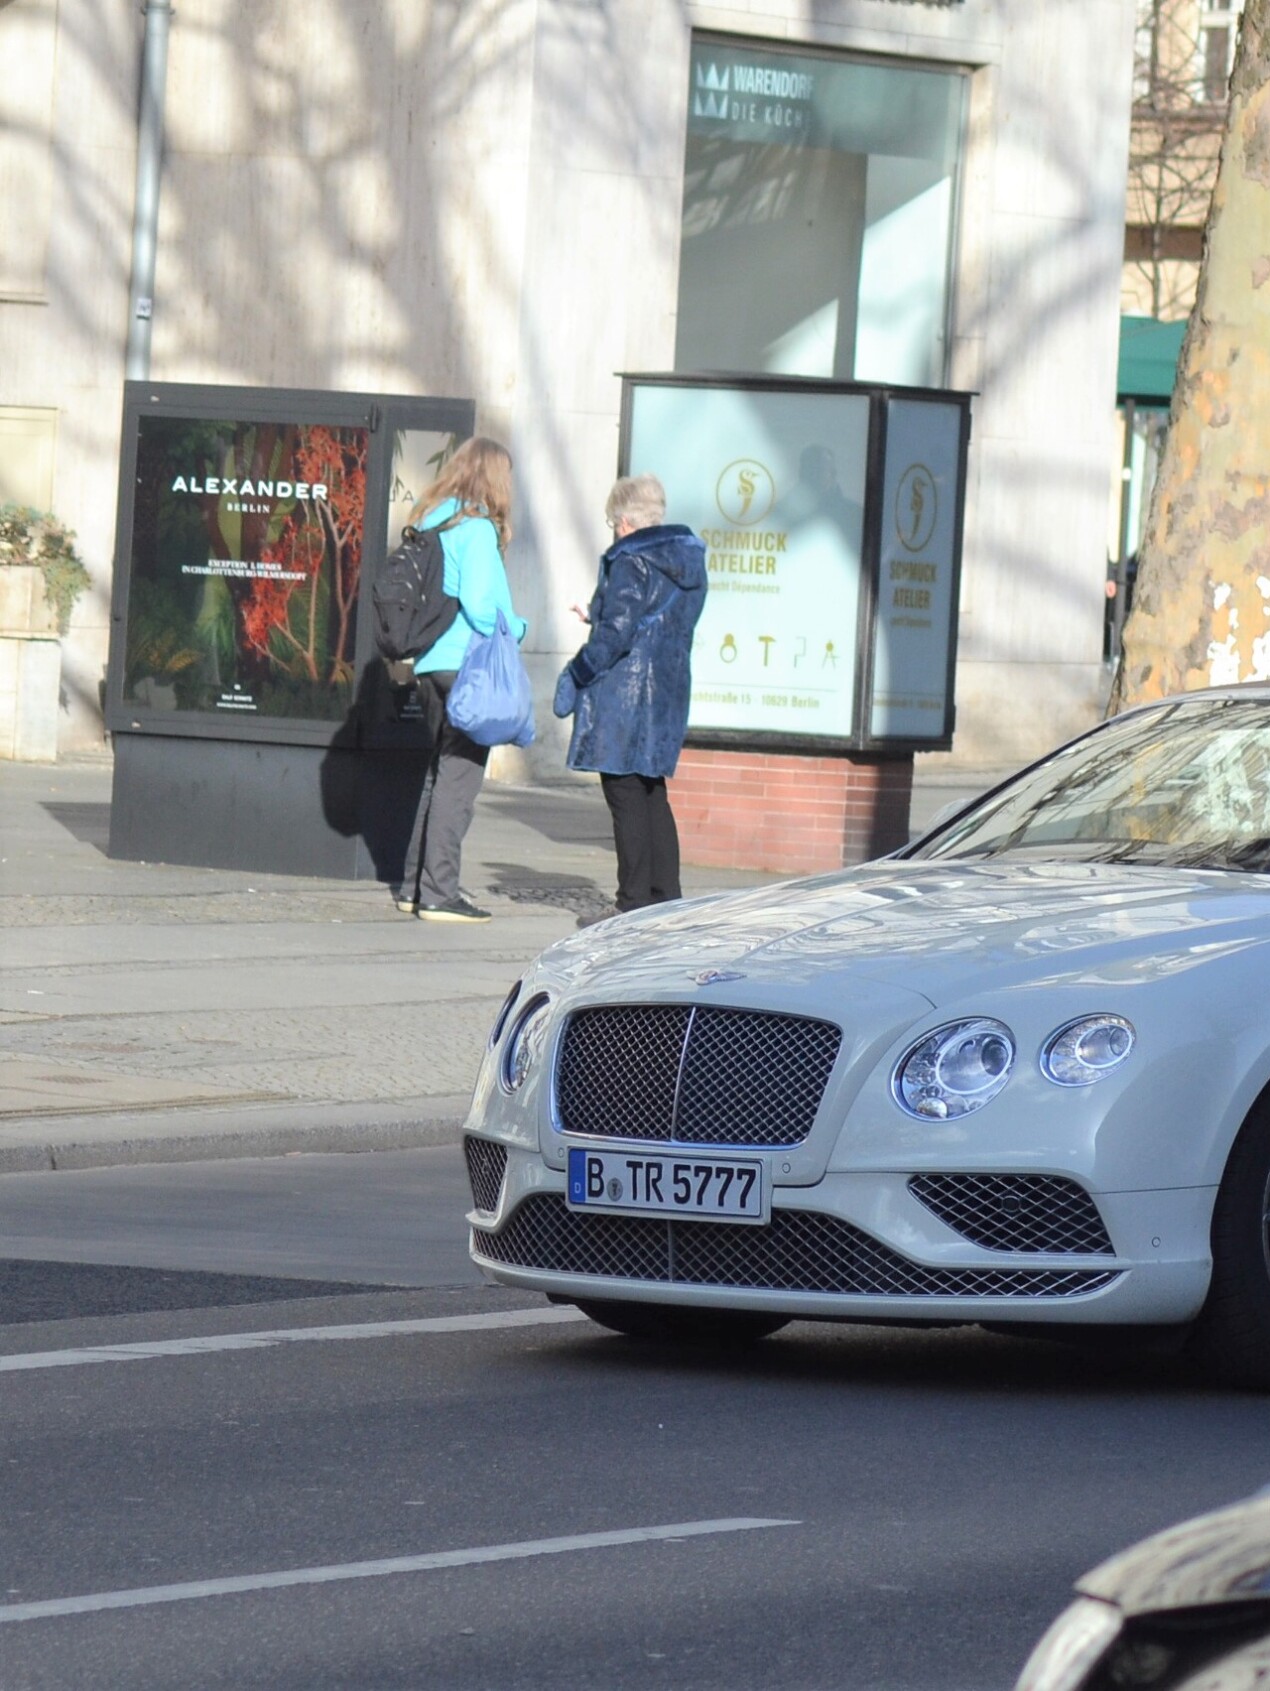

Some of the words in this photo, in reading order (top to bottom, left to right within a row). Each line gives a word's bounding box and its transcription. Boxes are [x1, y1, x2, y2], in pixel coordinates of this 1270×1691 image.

[733, 64, 814, 100] WARENDORF
[731, 101, 756, 122] DIE
[764, 103, 810, 129] KÜCH
[172, 476, 328, 500] ALEXANDER
[227, 502, 270, 514] BERLIN
[700, 528, 787, 552] SCHMUCK
[208, 559, 255, 569] EXCEPTIONL
[708, 552, 776, 575] ATELIER
[889, 560, 937, 582] SCHMUCK
[893, 588, 931, 609] ATELIER
[791, 695, 820, 708] Berlin
[587, 1157, 604, 1198] B
[626, 1160, 664, 1203] TR
[673, 1163, 757, 1209] 5777
